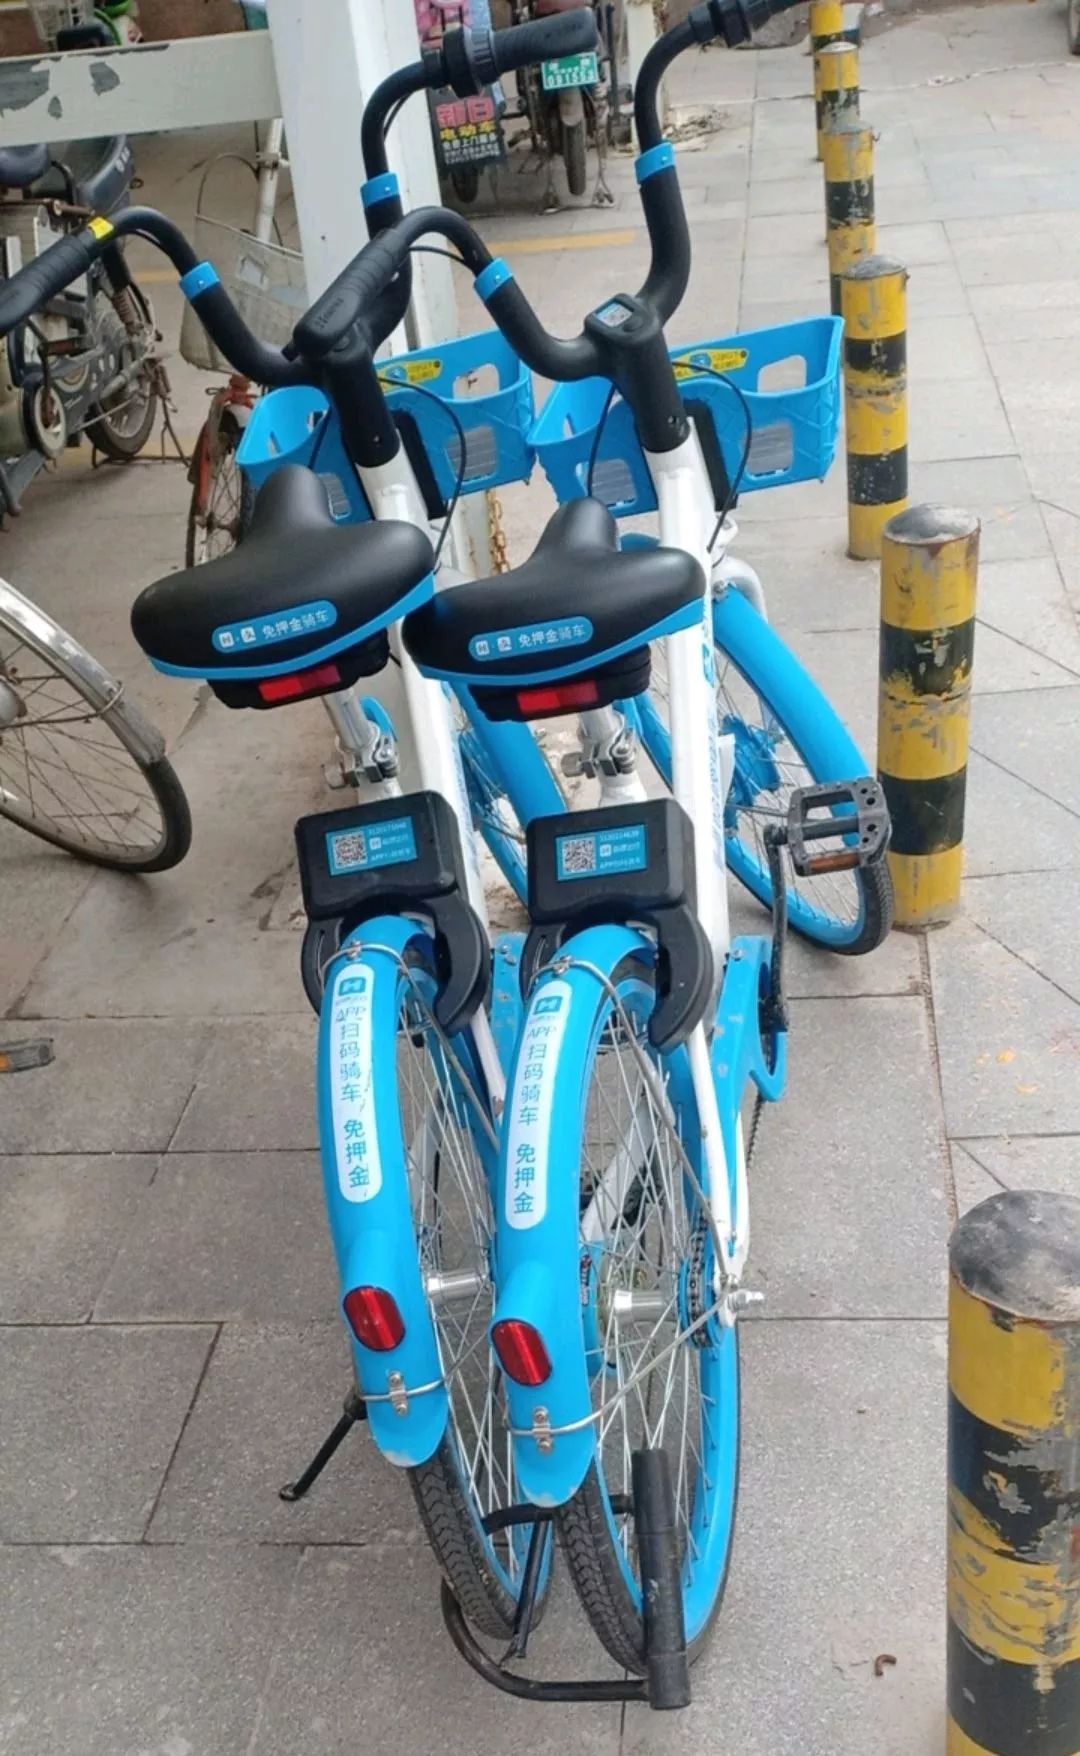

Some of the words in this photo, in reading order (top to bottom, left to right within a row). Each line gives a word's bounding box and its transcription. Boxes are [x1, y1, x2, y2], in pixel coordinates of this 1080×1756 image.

[262, 609, 329, 640] 免押金骑车
[518, 624, 585, 648] 免押金骑车
[343, 1118, 371, 1189] 免押金
[513, 1143, 537, 1215] 免押金
